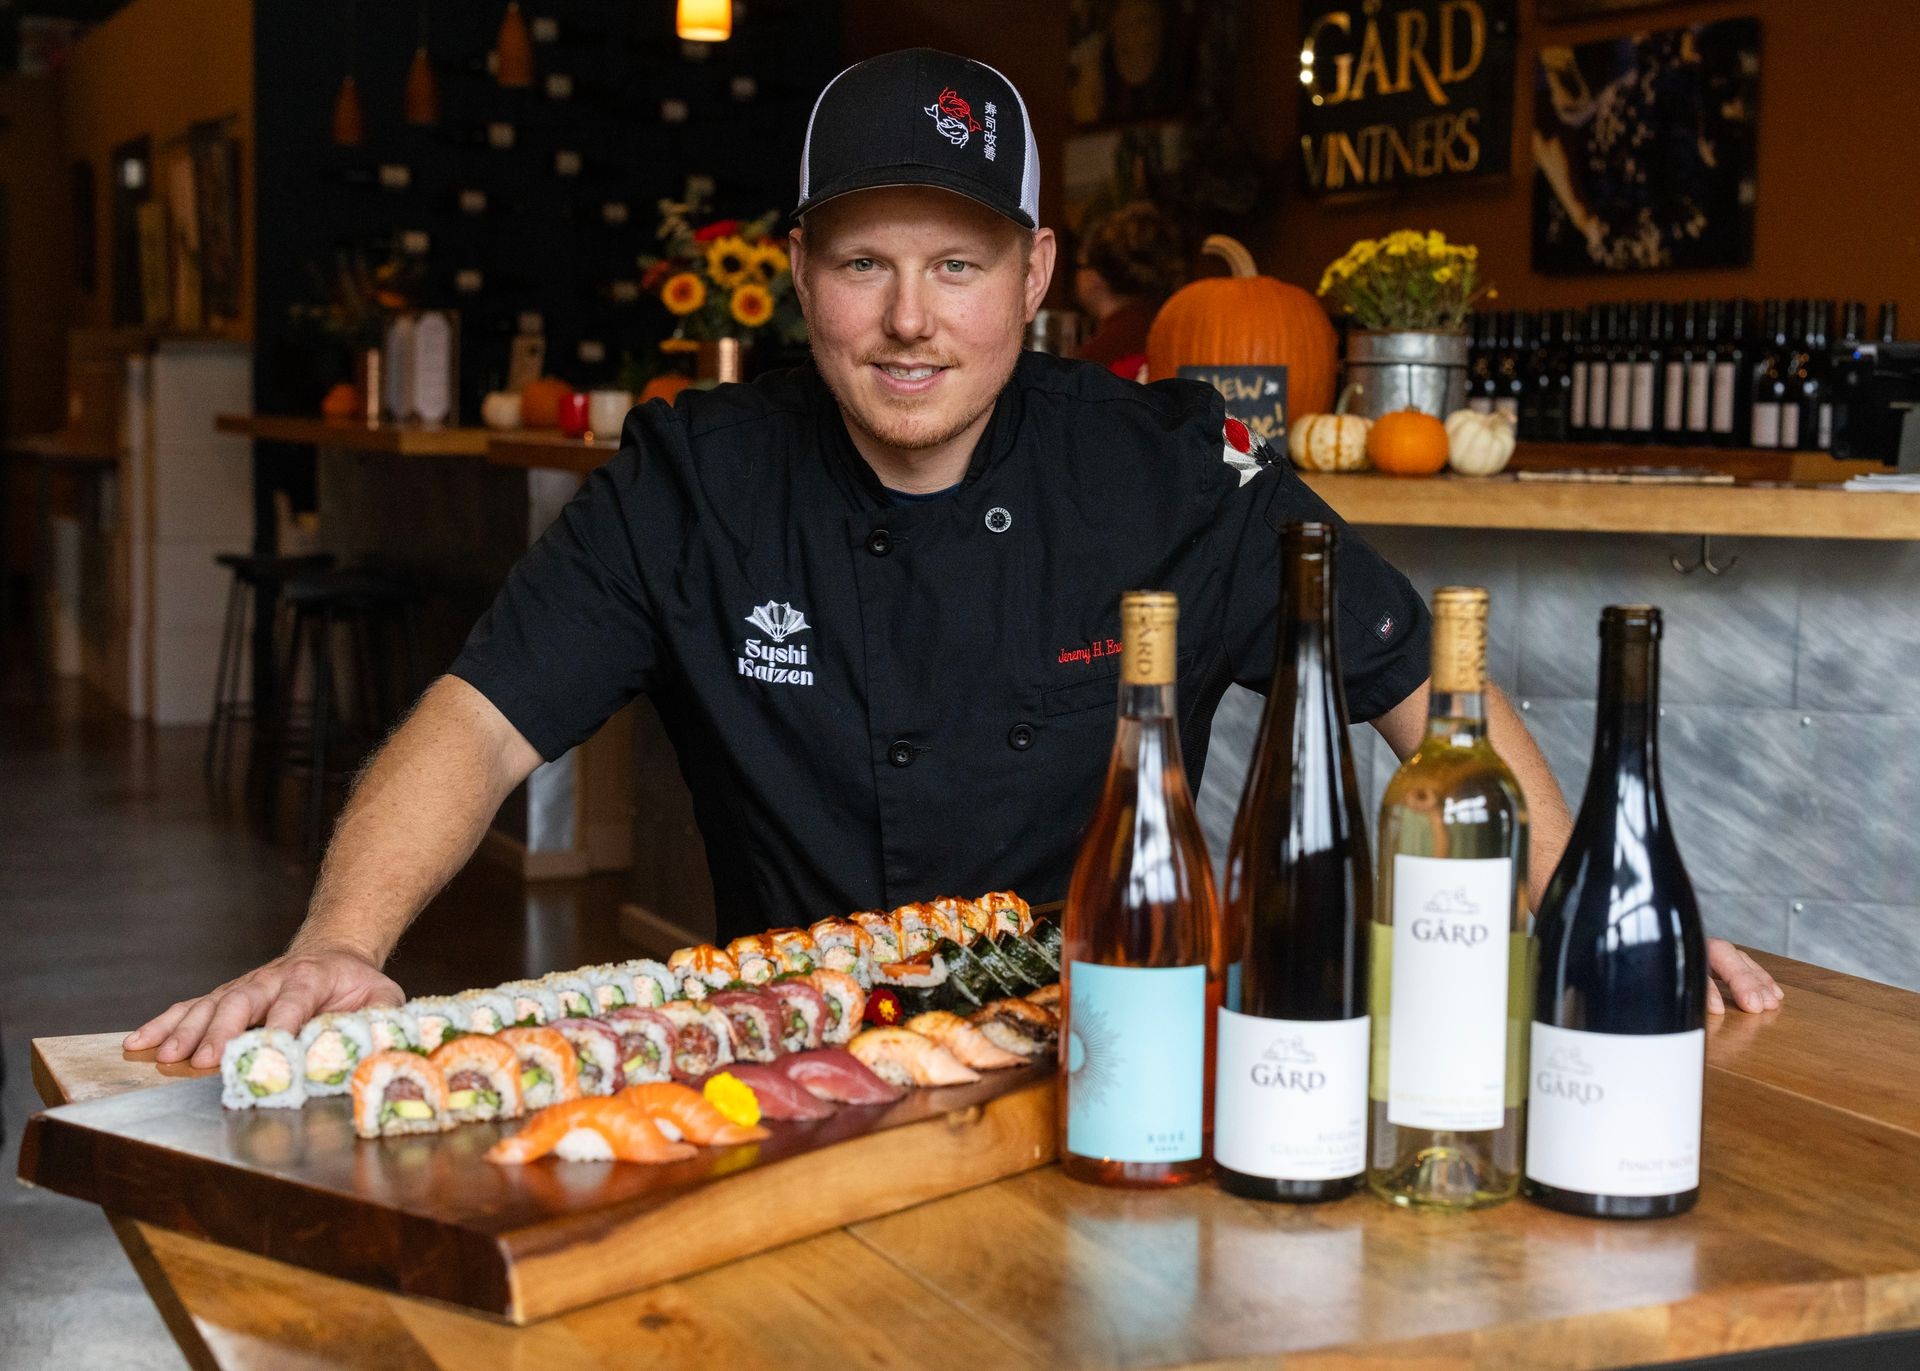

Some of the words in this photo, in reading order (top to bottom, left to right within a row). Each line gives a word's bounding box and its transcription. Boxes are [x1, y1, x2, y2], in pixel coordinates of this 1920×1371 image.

[1300, 107, 1480, 189] VINTNERS
[745, 639, 808, 665] Sushi
[1058, 648, 1091, 664] Jeremy
[1093, 641, 1104, 657] H.
[738, 657, 814, 685] Kaizen
